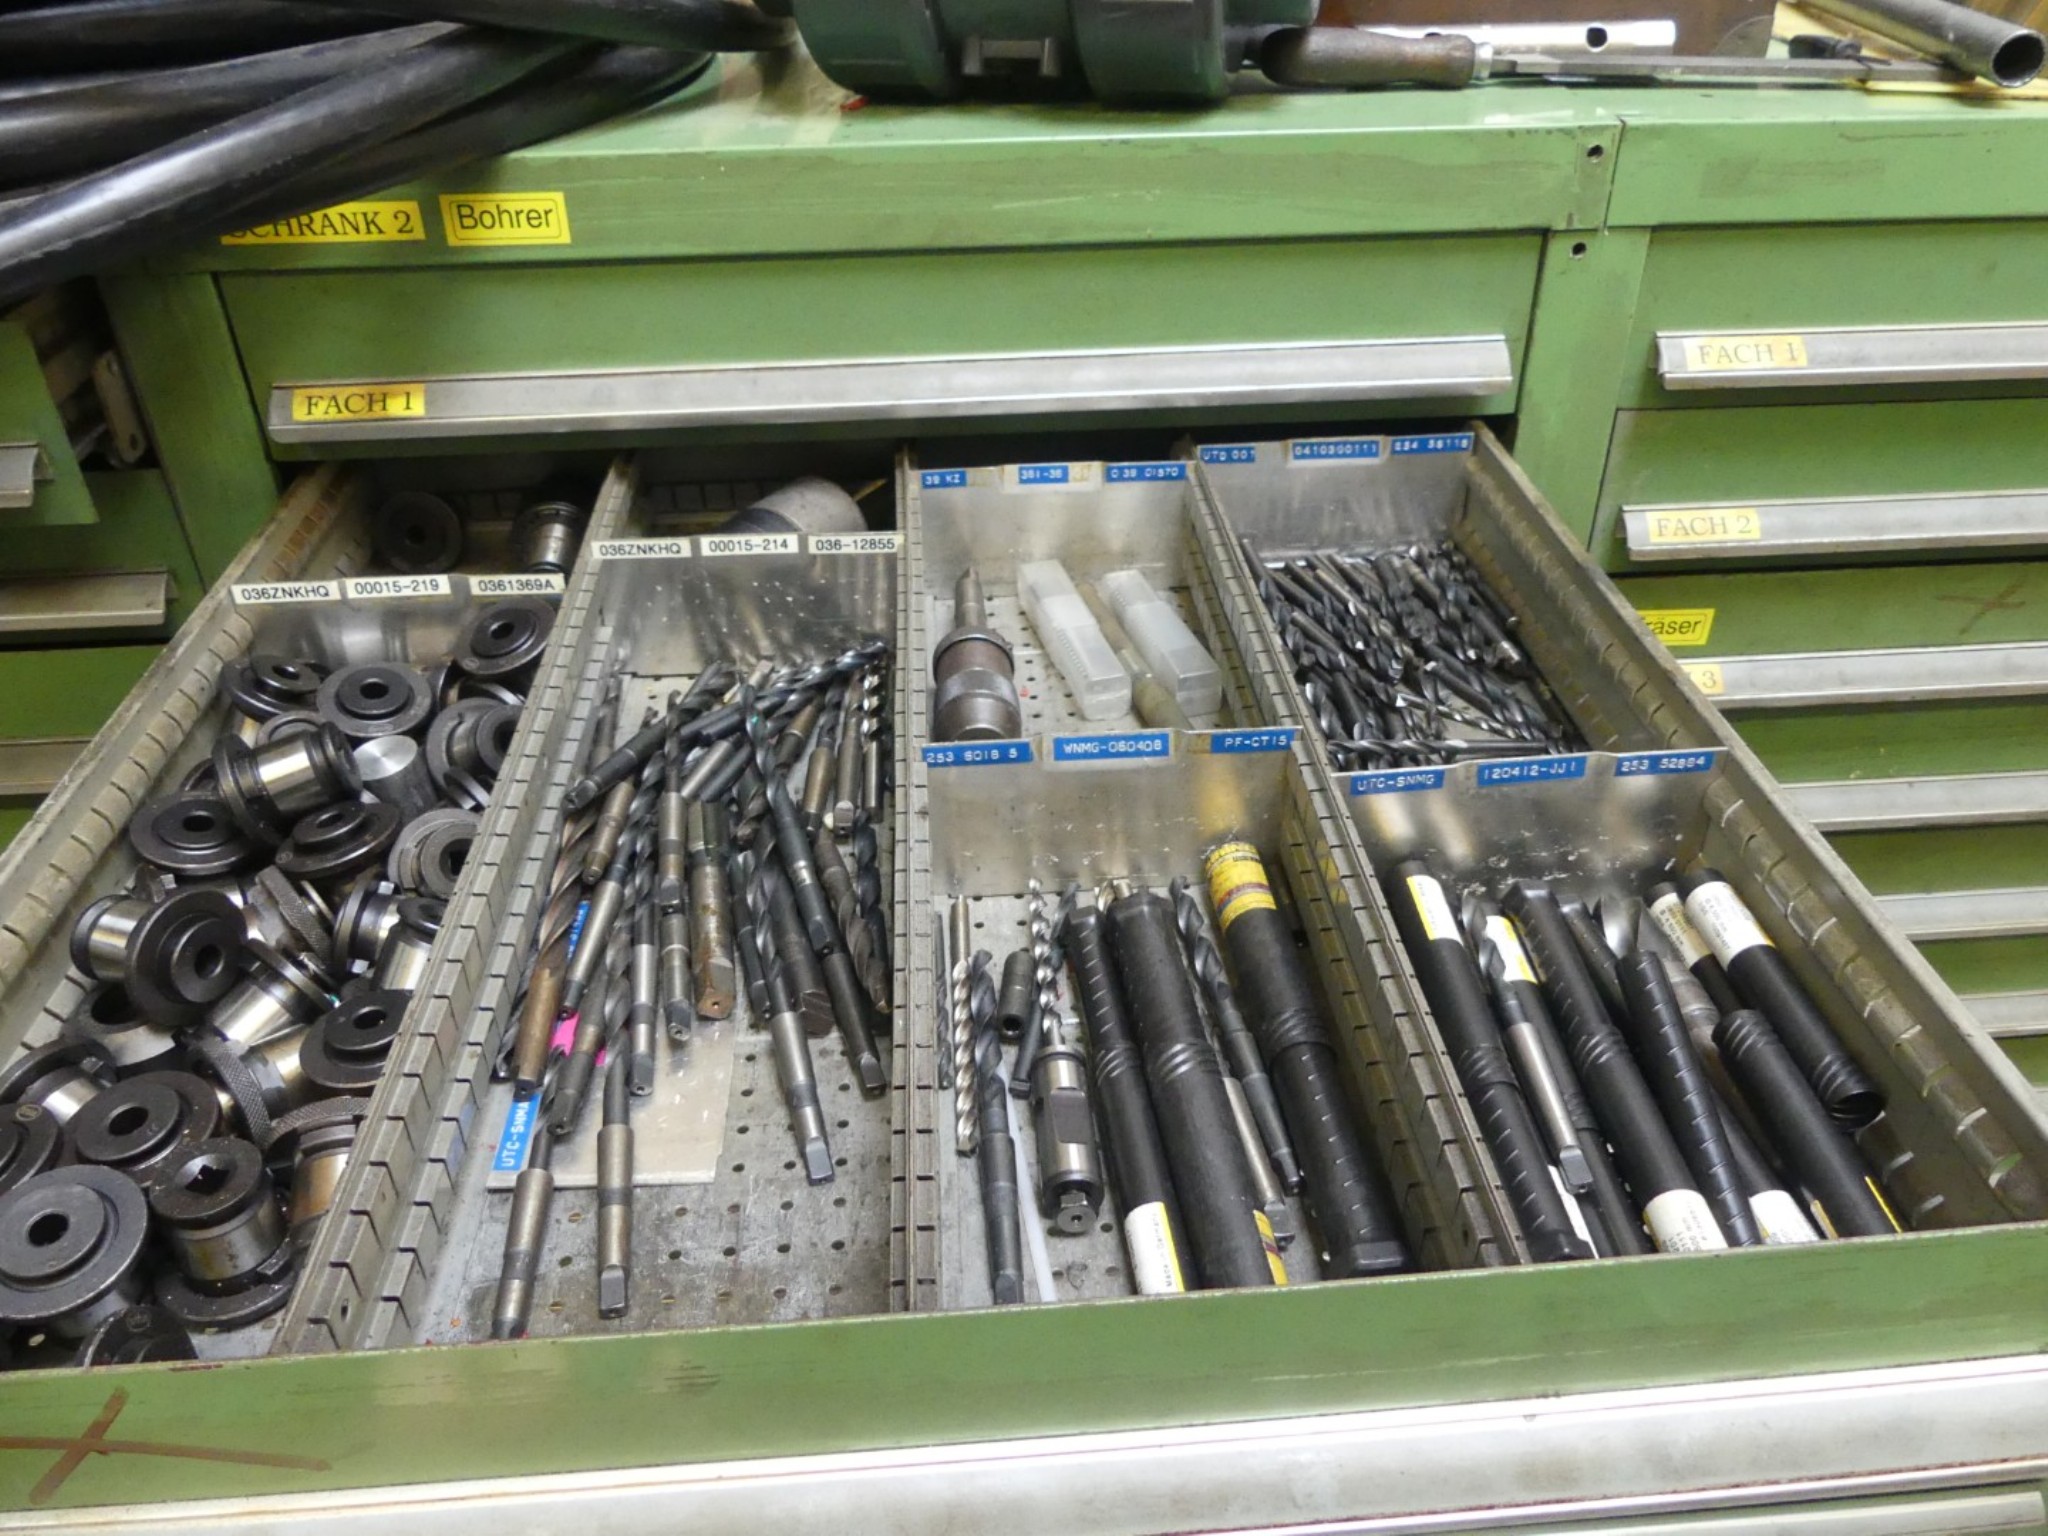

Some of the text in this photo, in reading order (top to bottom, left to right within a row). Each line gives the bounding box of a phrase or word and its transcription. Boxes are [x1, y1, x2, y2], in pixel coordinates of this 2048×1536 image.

[393, 209, 415, 234] 2
[456, 203, 553, 230] Bohrer
[1698, 342, 1799, 365] FACH 1
[305, 391, 413, 416] FACH 1
[1656, 515, 1752, 537] FACH 2
[600, 542, 682, 557] 036ZNKHQ
[708, 538, 789, 553] 00015-214
[815, 538, 896, 552] 036-12855
[241, 585, 331, 601] 036ZNKHQ
[353, 579, 440, 595] 00015-219
[478, 578, 556, 592] 0361369A
[1701, 670, 1717, 689] 3
[1224, 734, 1288, 748] PF-CT15
[1357, 774, 1435, 791] UTC-SNMG
